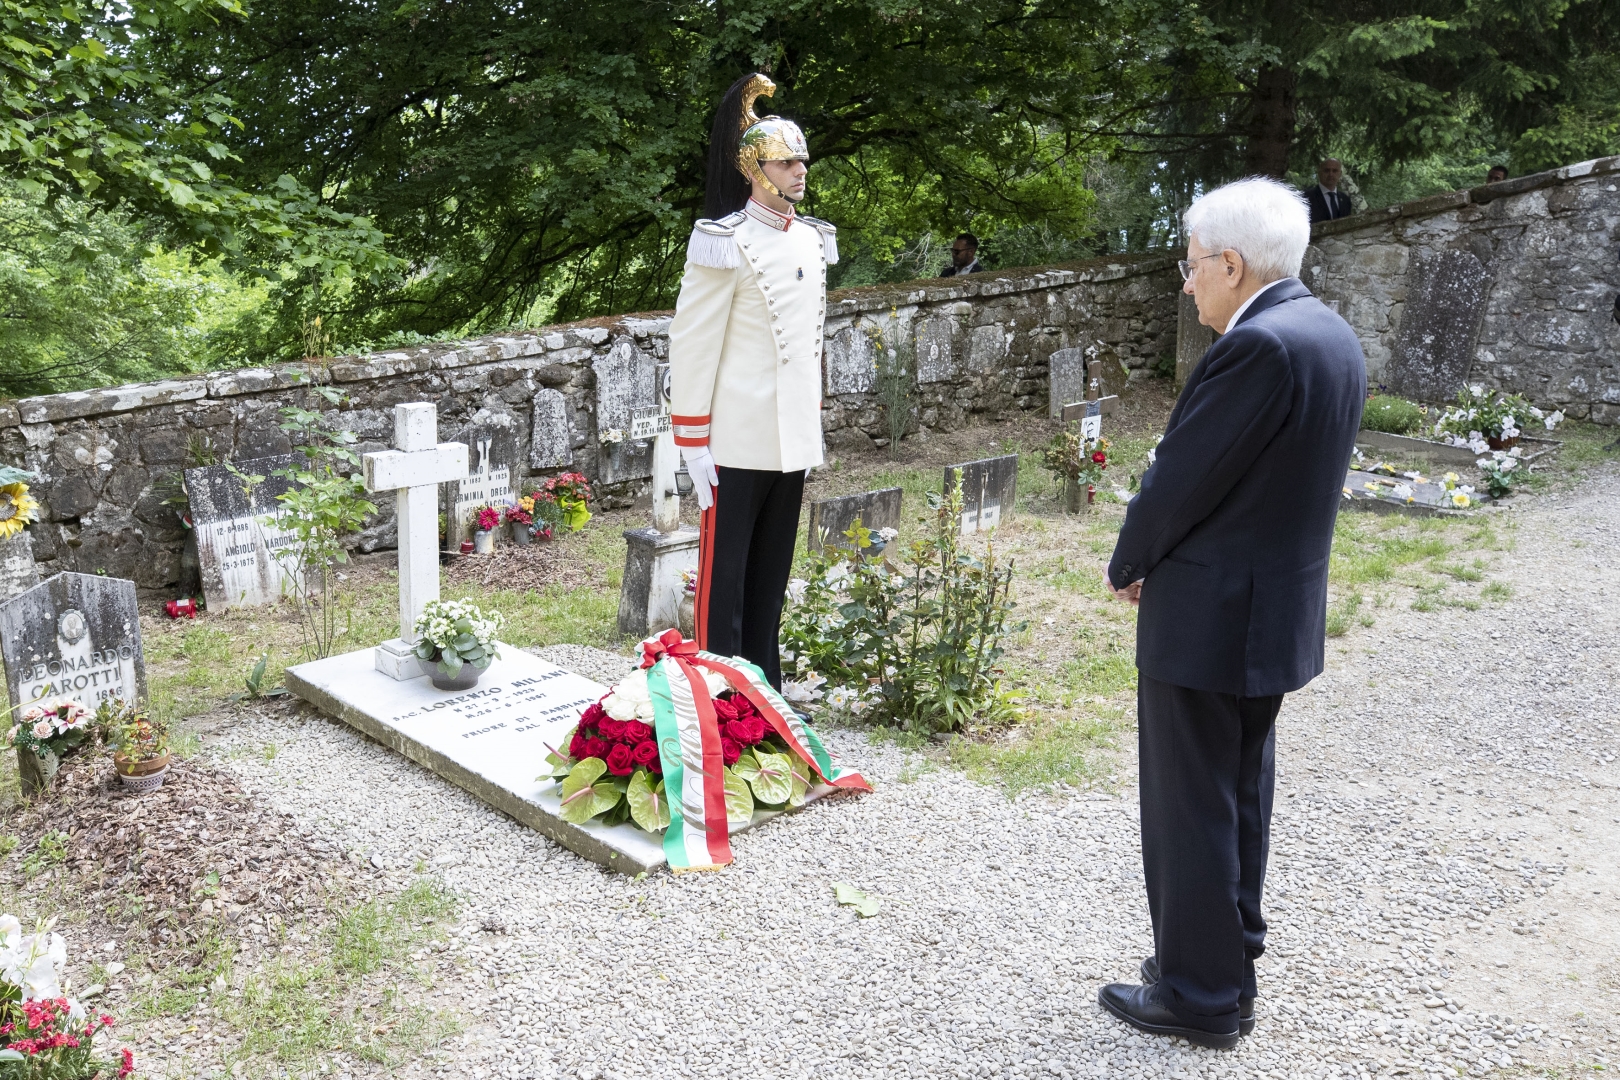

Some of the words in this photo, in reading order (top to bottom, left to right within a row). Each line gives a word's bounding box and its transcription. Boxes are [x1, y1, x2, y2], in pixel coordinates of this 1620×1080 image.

[636, 421, 653, 429] VED.
[225, 542, 256, 557] ANGIOLO
[20, 646, 133, 684] LEONARDO
[31, 666, 121, 700] CAROTTI
[420, 687, 502, 713] LORENZO
[510, 669, 569, 688] MILANI
